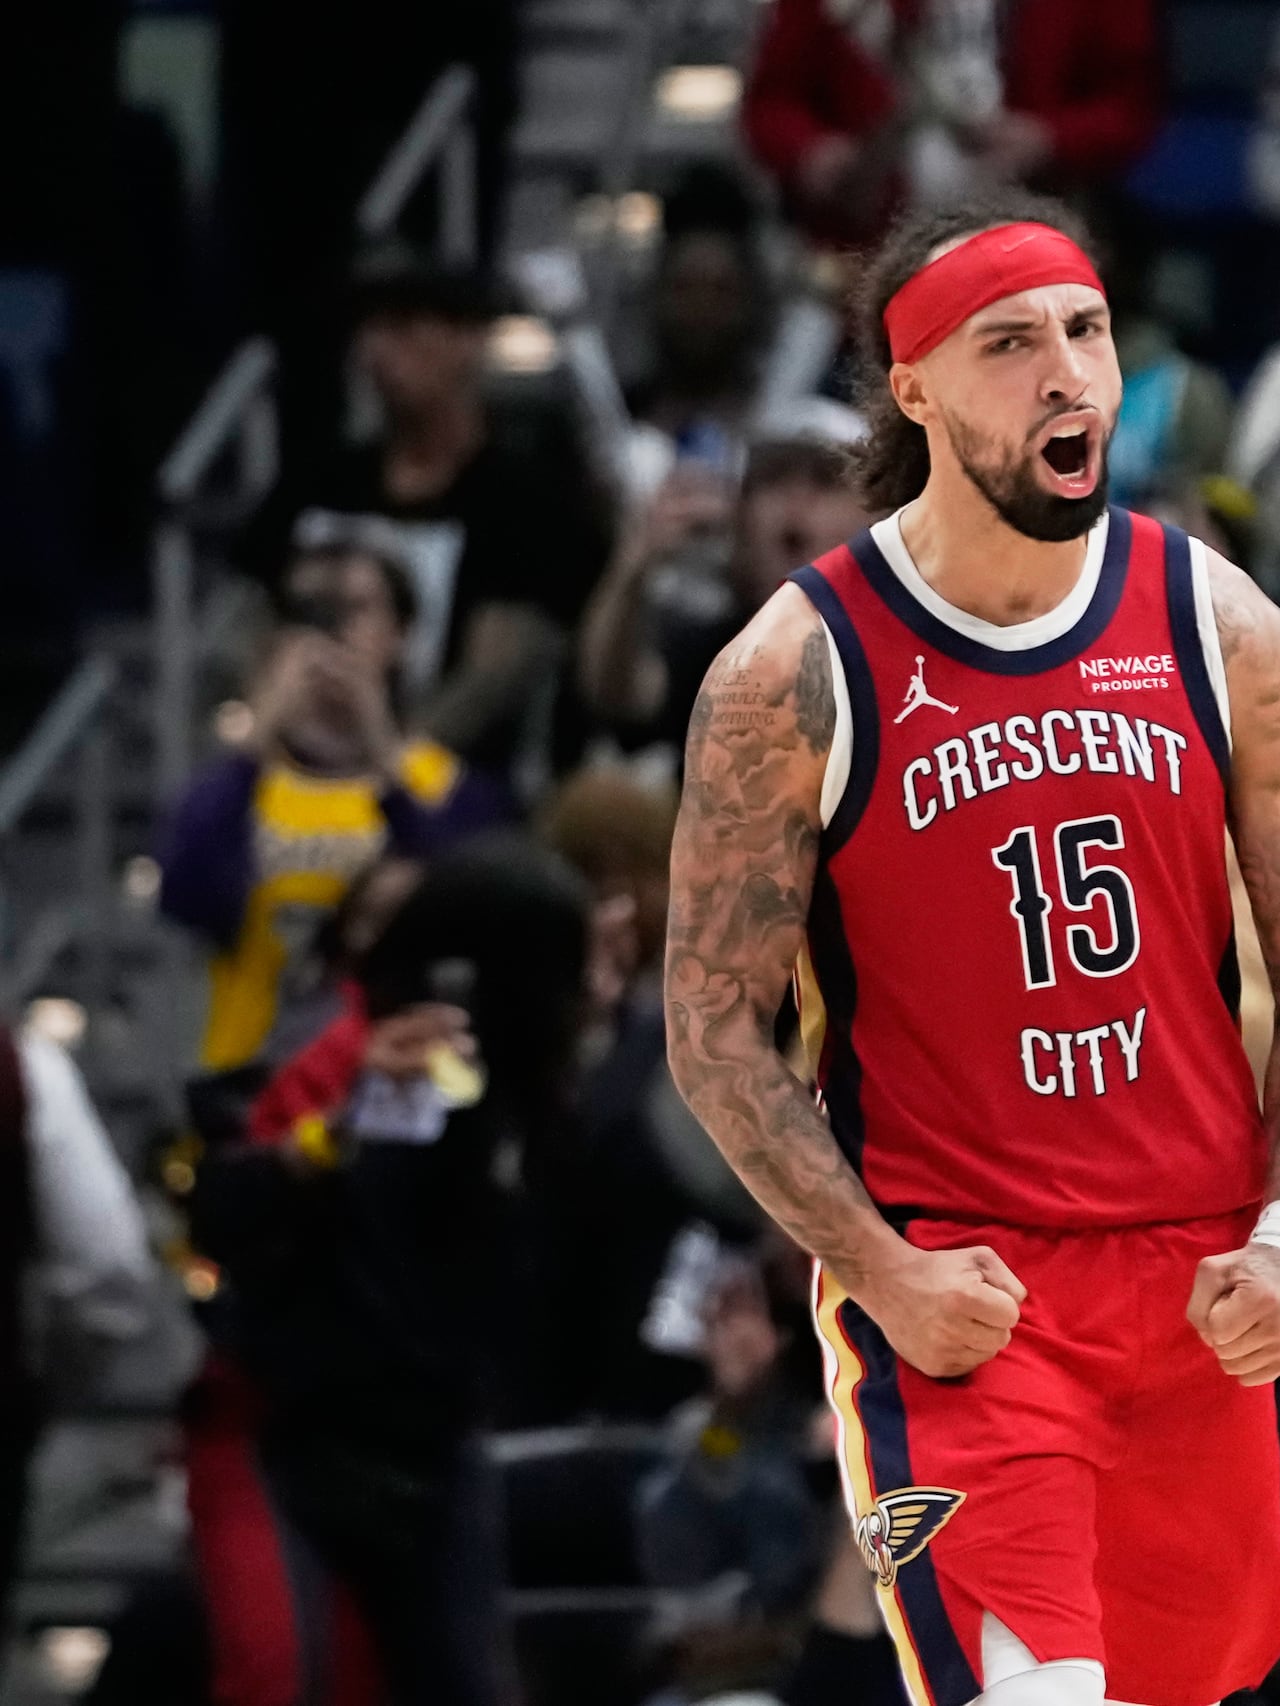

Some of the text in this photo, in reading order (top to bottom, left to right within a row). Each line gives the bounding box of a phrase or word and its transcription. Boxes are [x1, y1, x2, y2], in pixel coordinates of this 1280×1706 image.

[1079, 654, 1175, 679] NEWAGE
[1091, 677, 1169, 693] PRODUCTS
[902, 709, 1187, 832] CRESCENT
[991, 813, 1141, 991] 15
[1020, 1008, 1147, 1097] CITY
